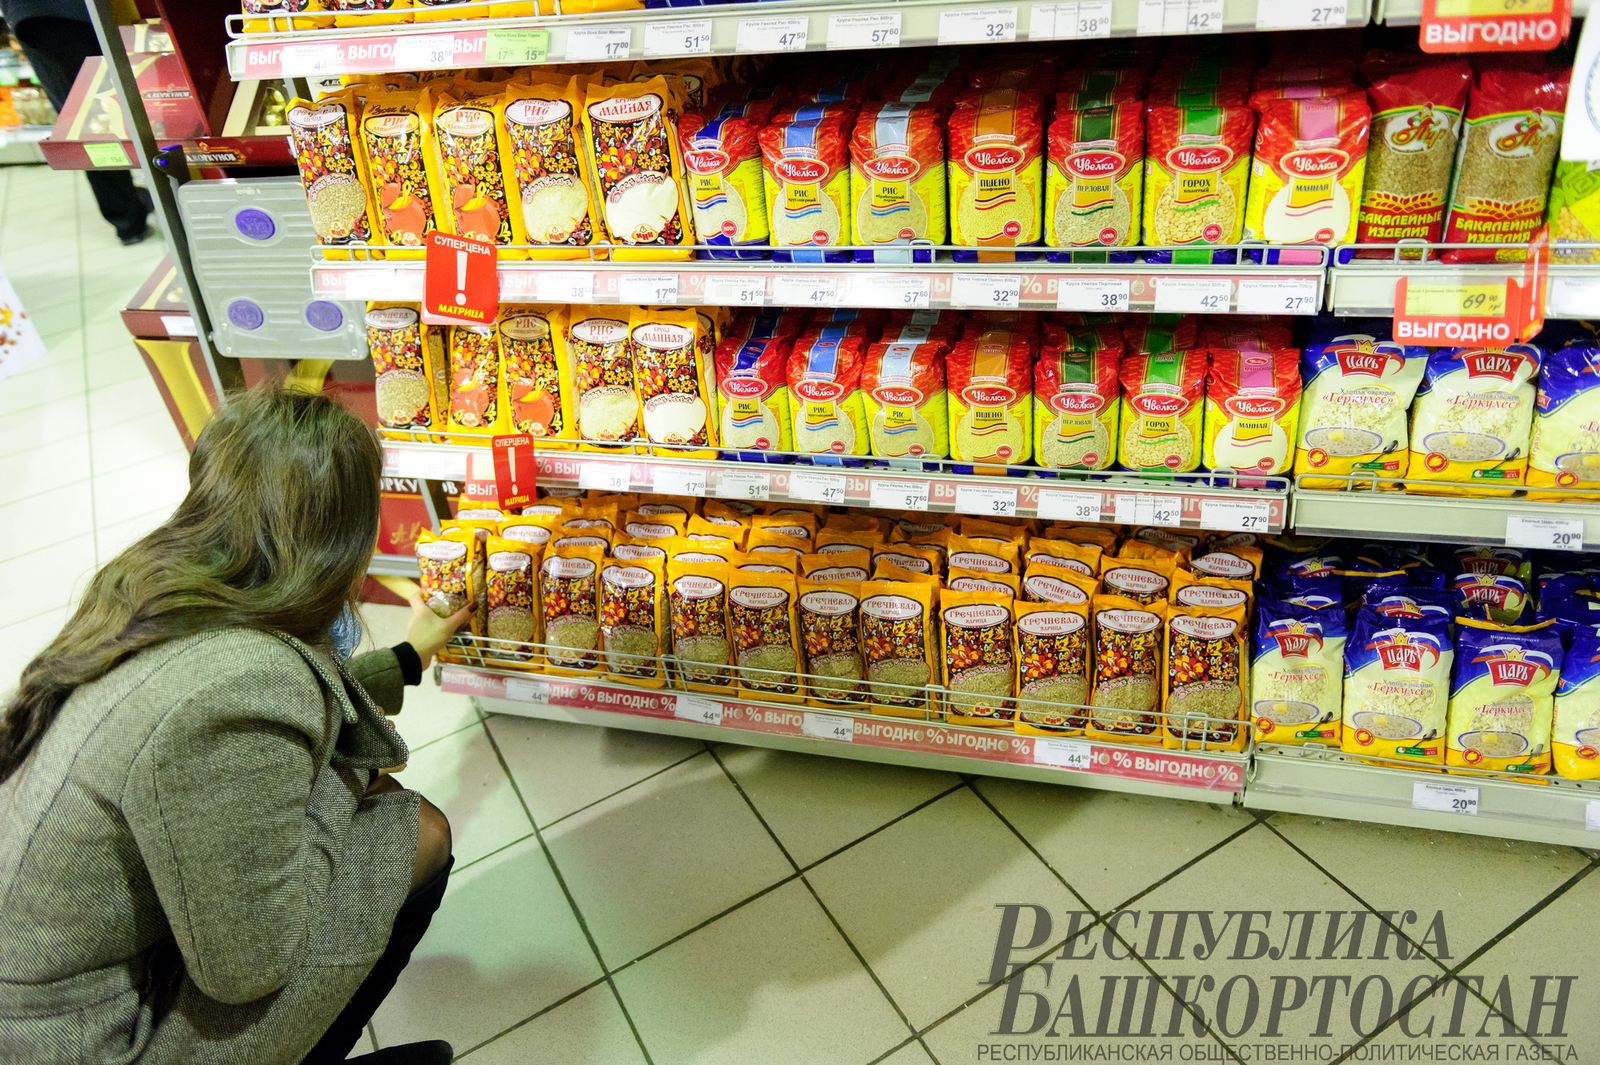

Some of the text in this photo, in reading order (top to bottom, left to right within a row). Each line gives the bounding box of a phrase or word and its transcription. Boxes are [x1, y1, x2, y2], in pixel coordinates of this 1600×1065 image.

[1426, 20, 1557, 45] ВЫГОДНО
[523, 105, 550, 118] РИС
[599, 101, 653, 117] МАННАЯ
[690, 156, 720, 169] Увелка
[975, 153, 1014, 167] Увелка
[1074, 157, 1114, 171] Увелка
[1178, 152, 1221, 166] Увелка
[1293, 157, 1338, 171] Увелка
[783, 164, 819, 178] Увелка
[875, 162, 909, 177] Увелка
[700, 178, 713, 187] РИС
[980, 178, 1010, 188] ПШЕНО
[1077, 184, 1109, 192] ПЕРЛОВАЯ
[1183, 179, 1211, 188] ГОРОХ
[1296, 184, 1329, 192] МАННАЯ
[794, 189, 809, 198] РИС
[882, 186, 898, 195] РИС
[1358, 211, 1442, 226] БАКАЛЕЙНЫЕ
[1368, 226, 1429, 238] ИЗДЕЛИЯ
[1467, 232, 1531, 243] ИЗДЕЛИЯ
[434, 235, 491, 257] СУПЕРЦЕНА
[437, 303, 485, 320] МАТРИЦА
[514, 318, 537, 329] РИС
[589, 325, 614, 337] РИС
[1397, 321, 1511, 342] ВЫГОДНО
[641, 332, 684, 344] МАННАЯ
[1346, 355, 1380, 370] ЦАРЬ
[1475, 357, 1511, 373] ЦАРЬ
[729, 381, 760, 393] Увелка
[803, 384, 835, 397] Увелка
[880, 390, 914, 403] Увелка
[971, 389, 1007, 403] Увелка
[738, 402, 752, 411] РИС
[813, 406, 827, 414] РИС
[1061, 397, 1097, 411] Увелка
[1141, 398, 1179, 412] Увелка
[1235, 401, 1275, 414] Увелка
[892, 410, 906, 419] РИС
[975, 411, 1003, 419] ПШЕНО
[1062, 419, 1091, 427] ПЕРЛОВАЯ
[1145, 420, 1170, 429] ГОРОХ
[1239, 422, 1268, 430] МАННАЯ
[495, 437, 530, 448] СУПЕРЦЕНА
[504, 494, 530, 507] МАТРИЦА
[953, 556, 1005, 568] ГРЕЧНЕВАЯ
[812, 571, 861, 582] ГРЕЧНЕВАЯ
[1110, 573, 1164, 587] ГРЕЧНЕВАЯ
[734, 590, 783, 599] ГРЕЧНЕВАЯ
[1032, 579, 1082, 600] ГРЕЧНЕВАЯ
[1183, 589, 1242, 600] ГРЕЧНЕВАЯ
[805, 596, 853, 607] ГРЕЧНЕВАЯ
[1472, 589, 1500, 605] ЦАРЬ
[866, 600, 917, 611] ГРЕЧНЕВАЯ
[949, 609, 1003, 618] ГРЕЧНЕВАЯ
[1102, 613, 1156, 624] ГРЕЧНЕВАЯ
[1023, 616, 1078, 626] ГРЕЧНЕВАЯ
[1177, 618, 1233, 630] ГРЕЧНЕВАЯ
[1386, 648, 1417, 665] ЦАРЬ
[1497, 664, 1529, 681] ЦАРЬ
[597, 691, 660, 710] ВЫГОДНО
[764, 711, 804, 729] ВЫГО
[853, 722, 924, 744] ВЫГОДНО
[1135, 756, 1215, 780] ВЫГОДНО
